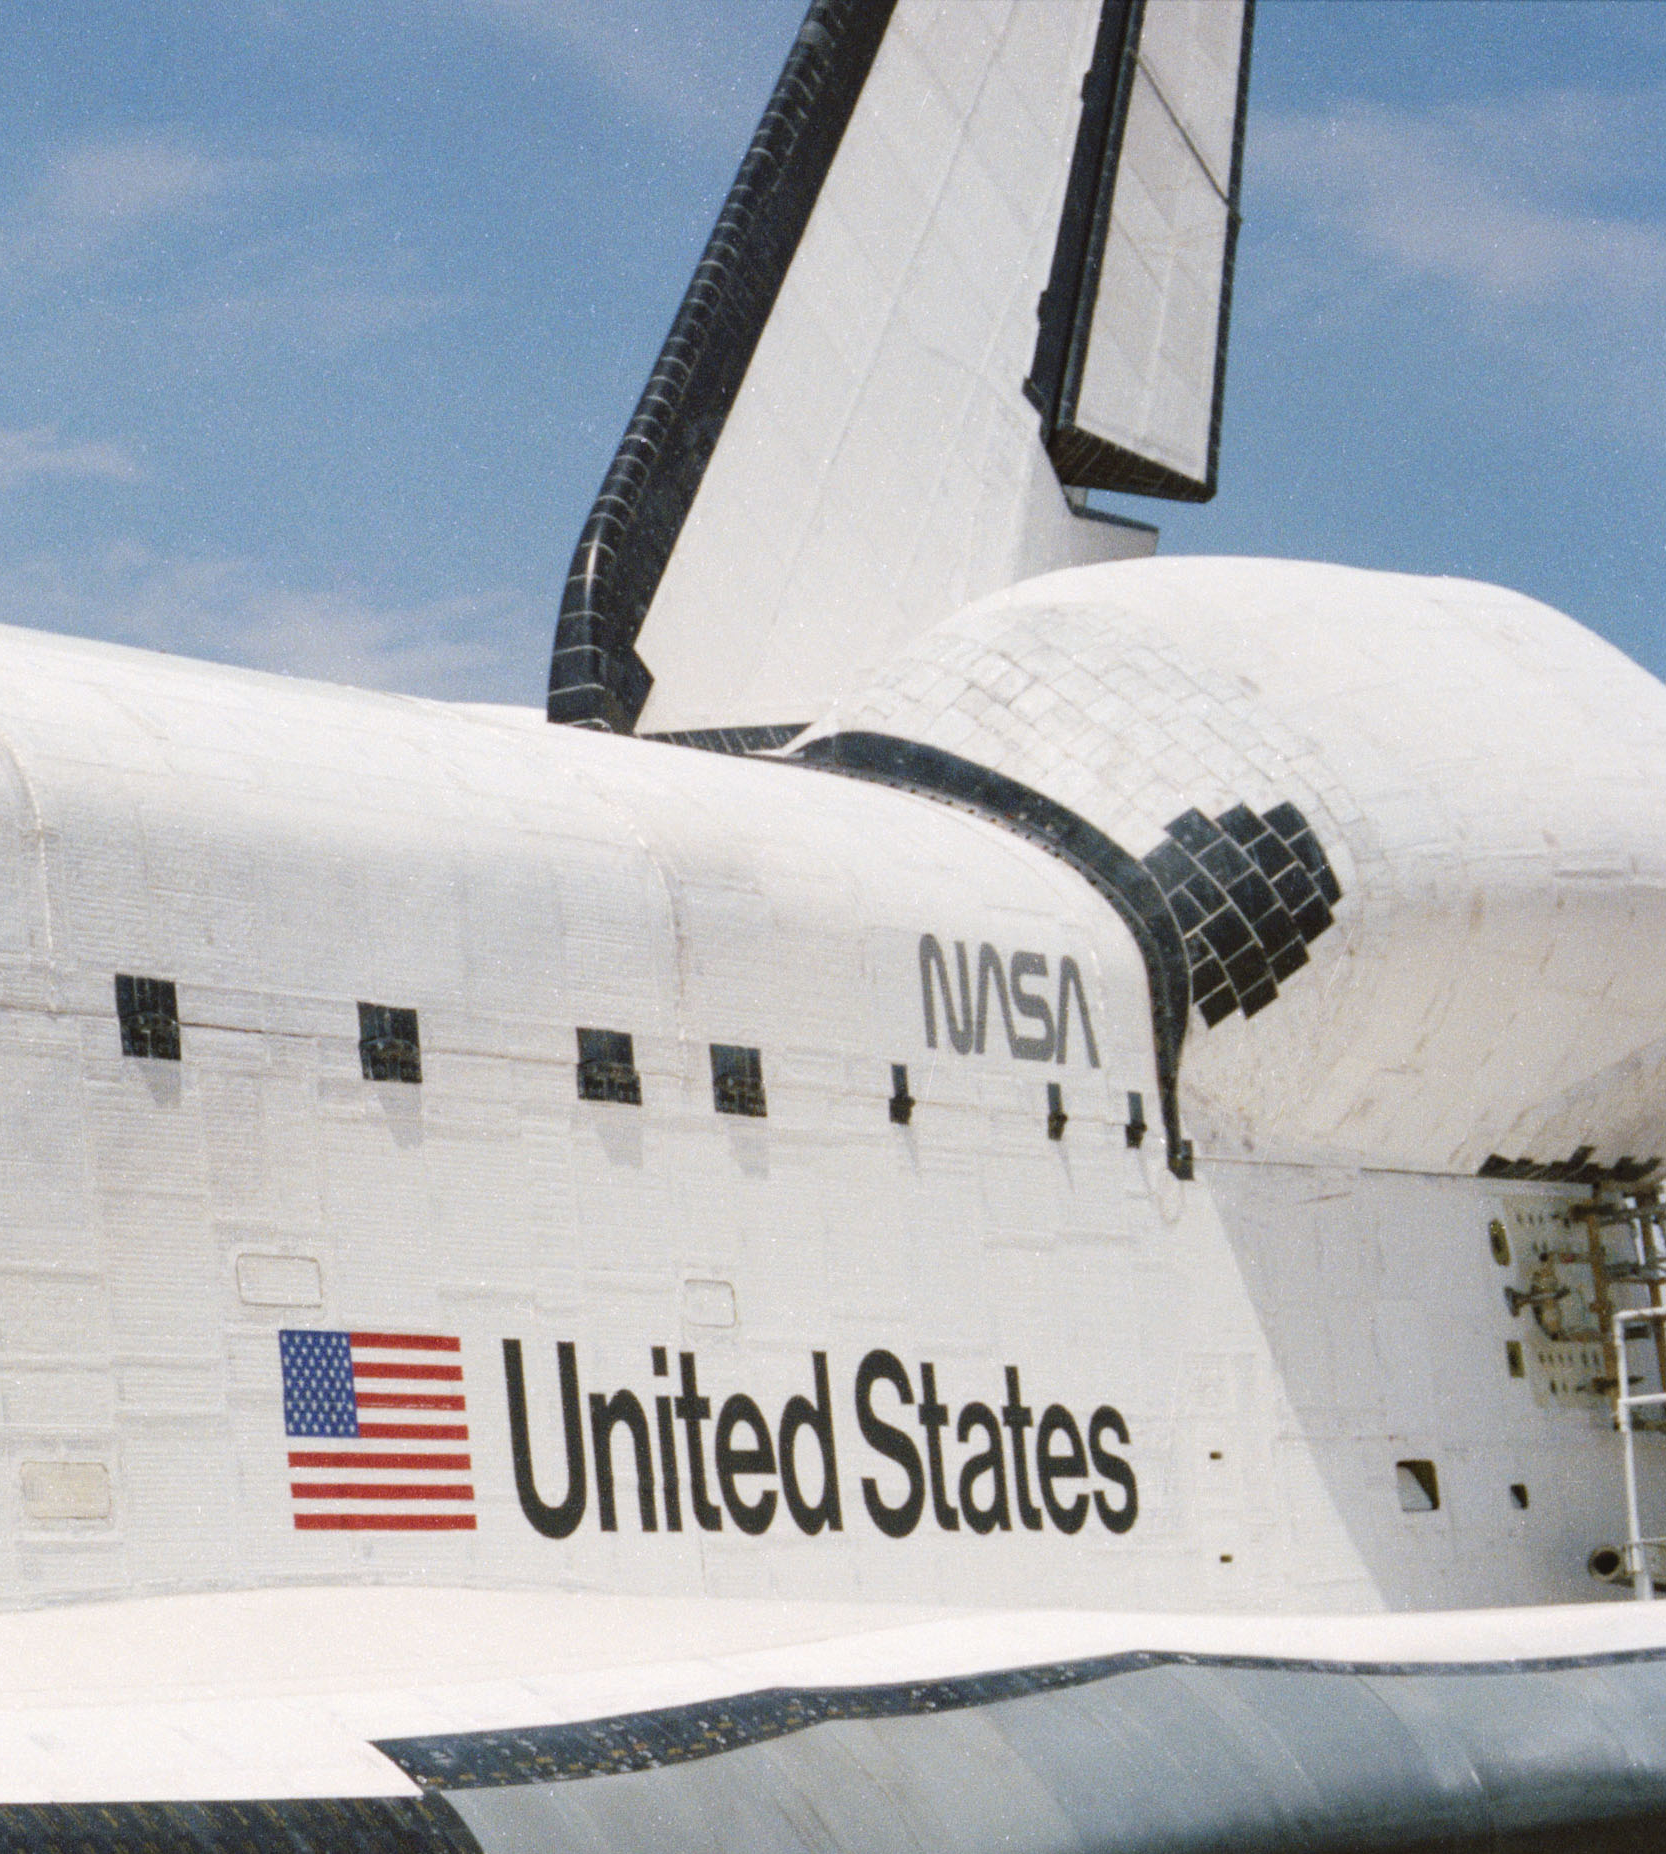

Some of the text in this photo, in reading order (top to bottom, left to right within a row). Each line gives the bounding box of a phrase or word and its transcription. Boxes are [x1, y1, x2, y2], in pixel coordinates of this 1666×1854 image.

[919, 933, 1101, 1069] NASA
[502, 1338, 1139, 1539] United States
